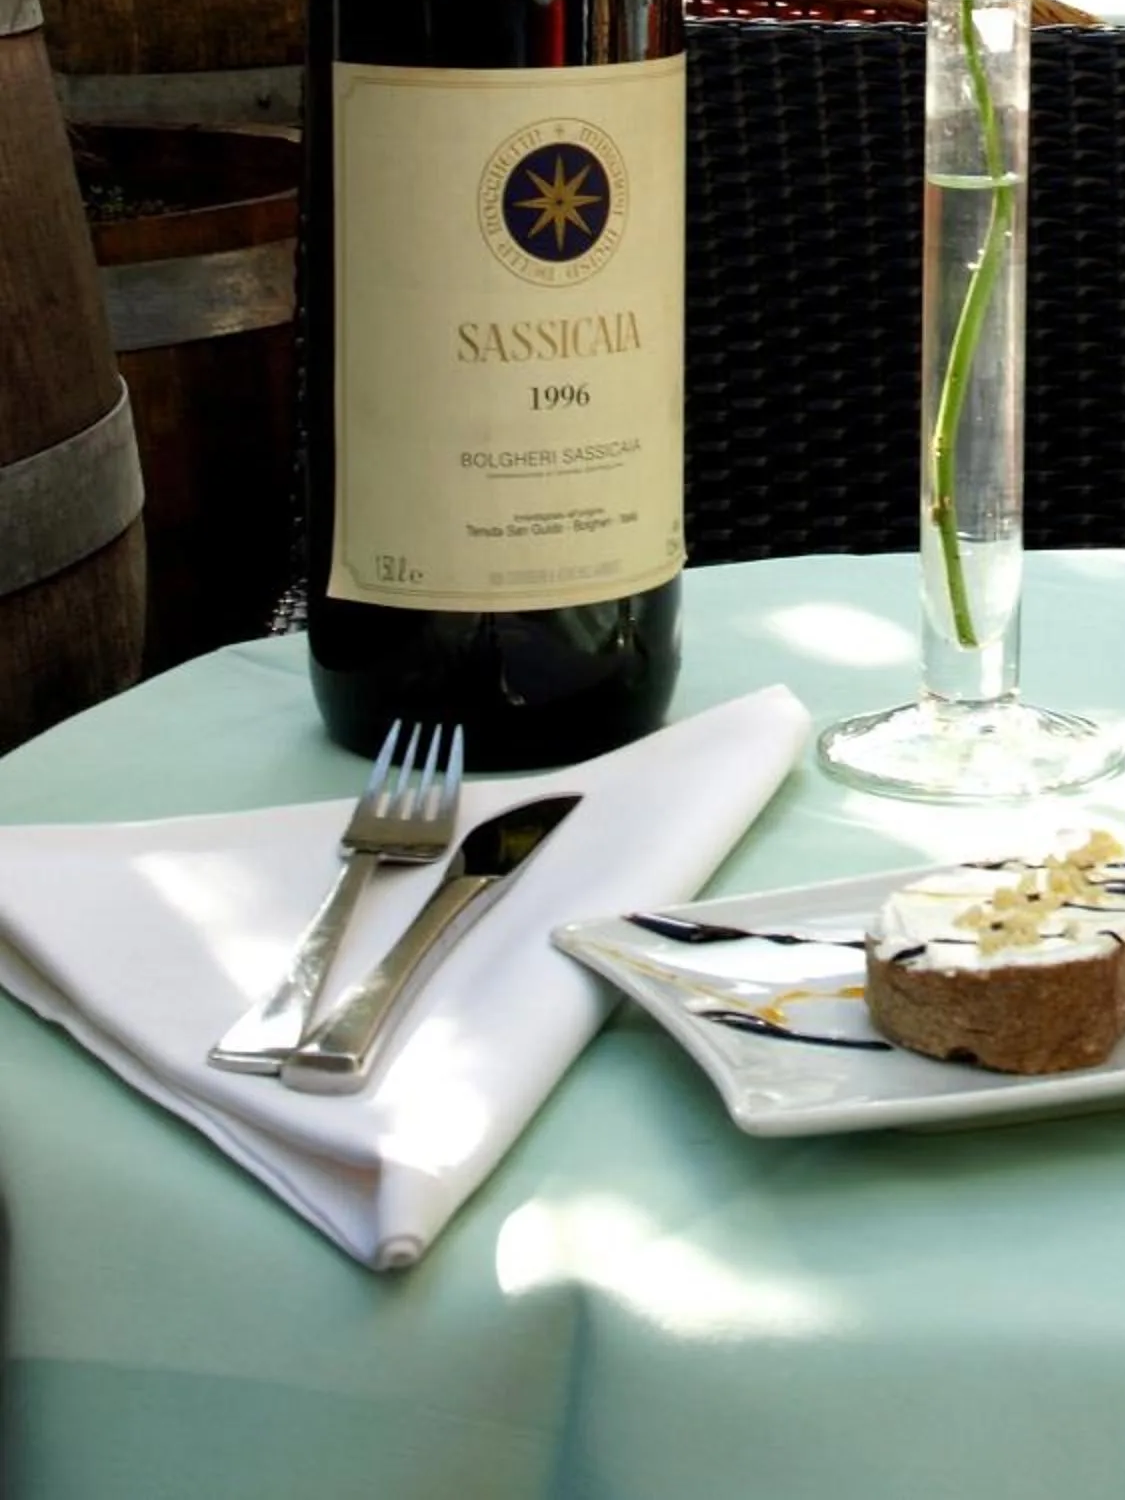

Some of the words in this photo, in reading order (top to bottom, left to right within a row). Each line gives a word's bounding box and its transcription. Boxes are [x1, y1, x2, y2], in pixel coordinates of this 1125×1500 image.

[457, 311, 641, 364] SASSICAIA
[530, 384, 591, 411] 1996
[459, 449, 559, 471] BOLGHERI
[562, 439, 641, 464] SASSICAIA
